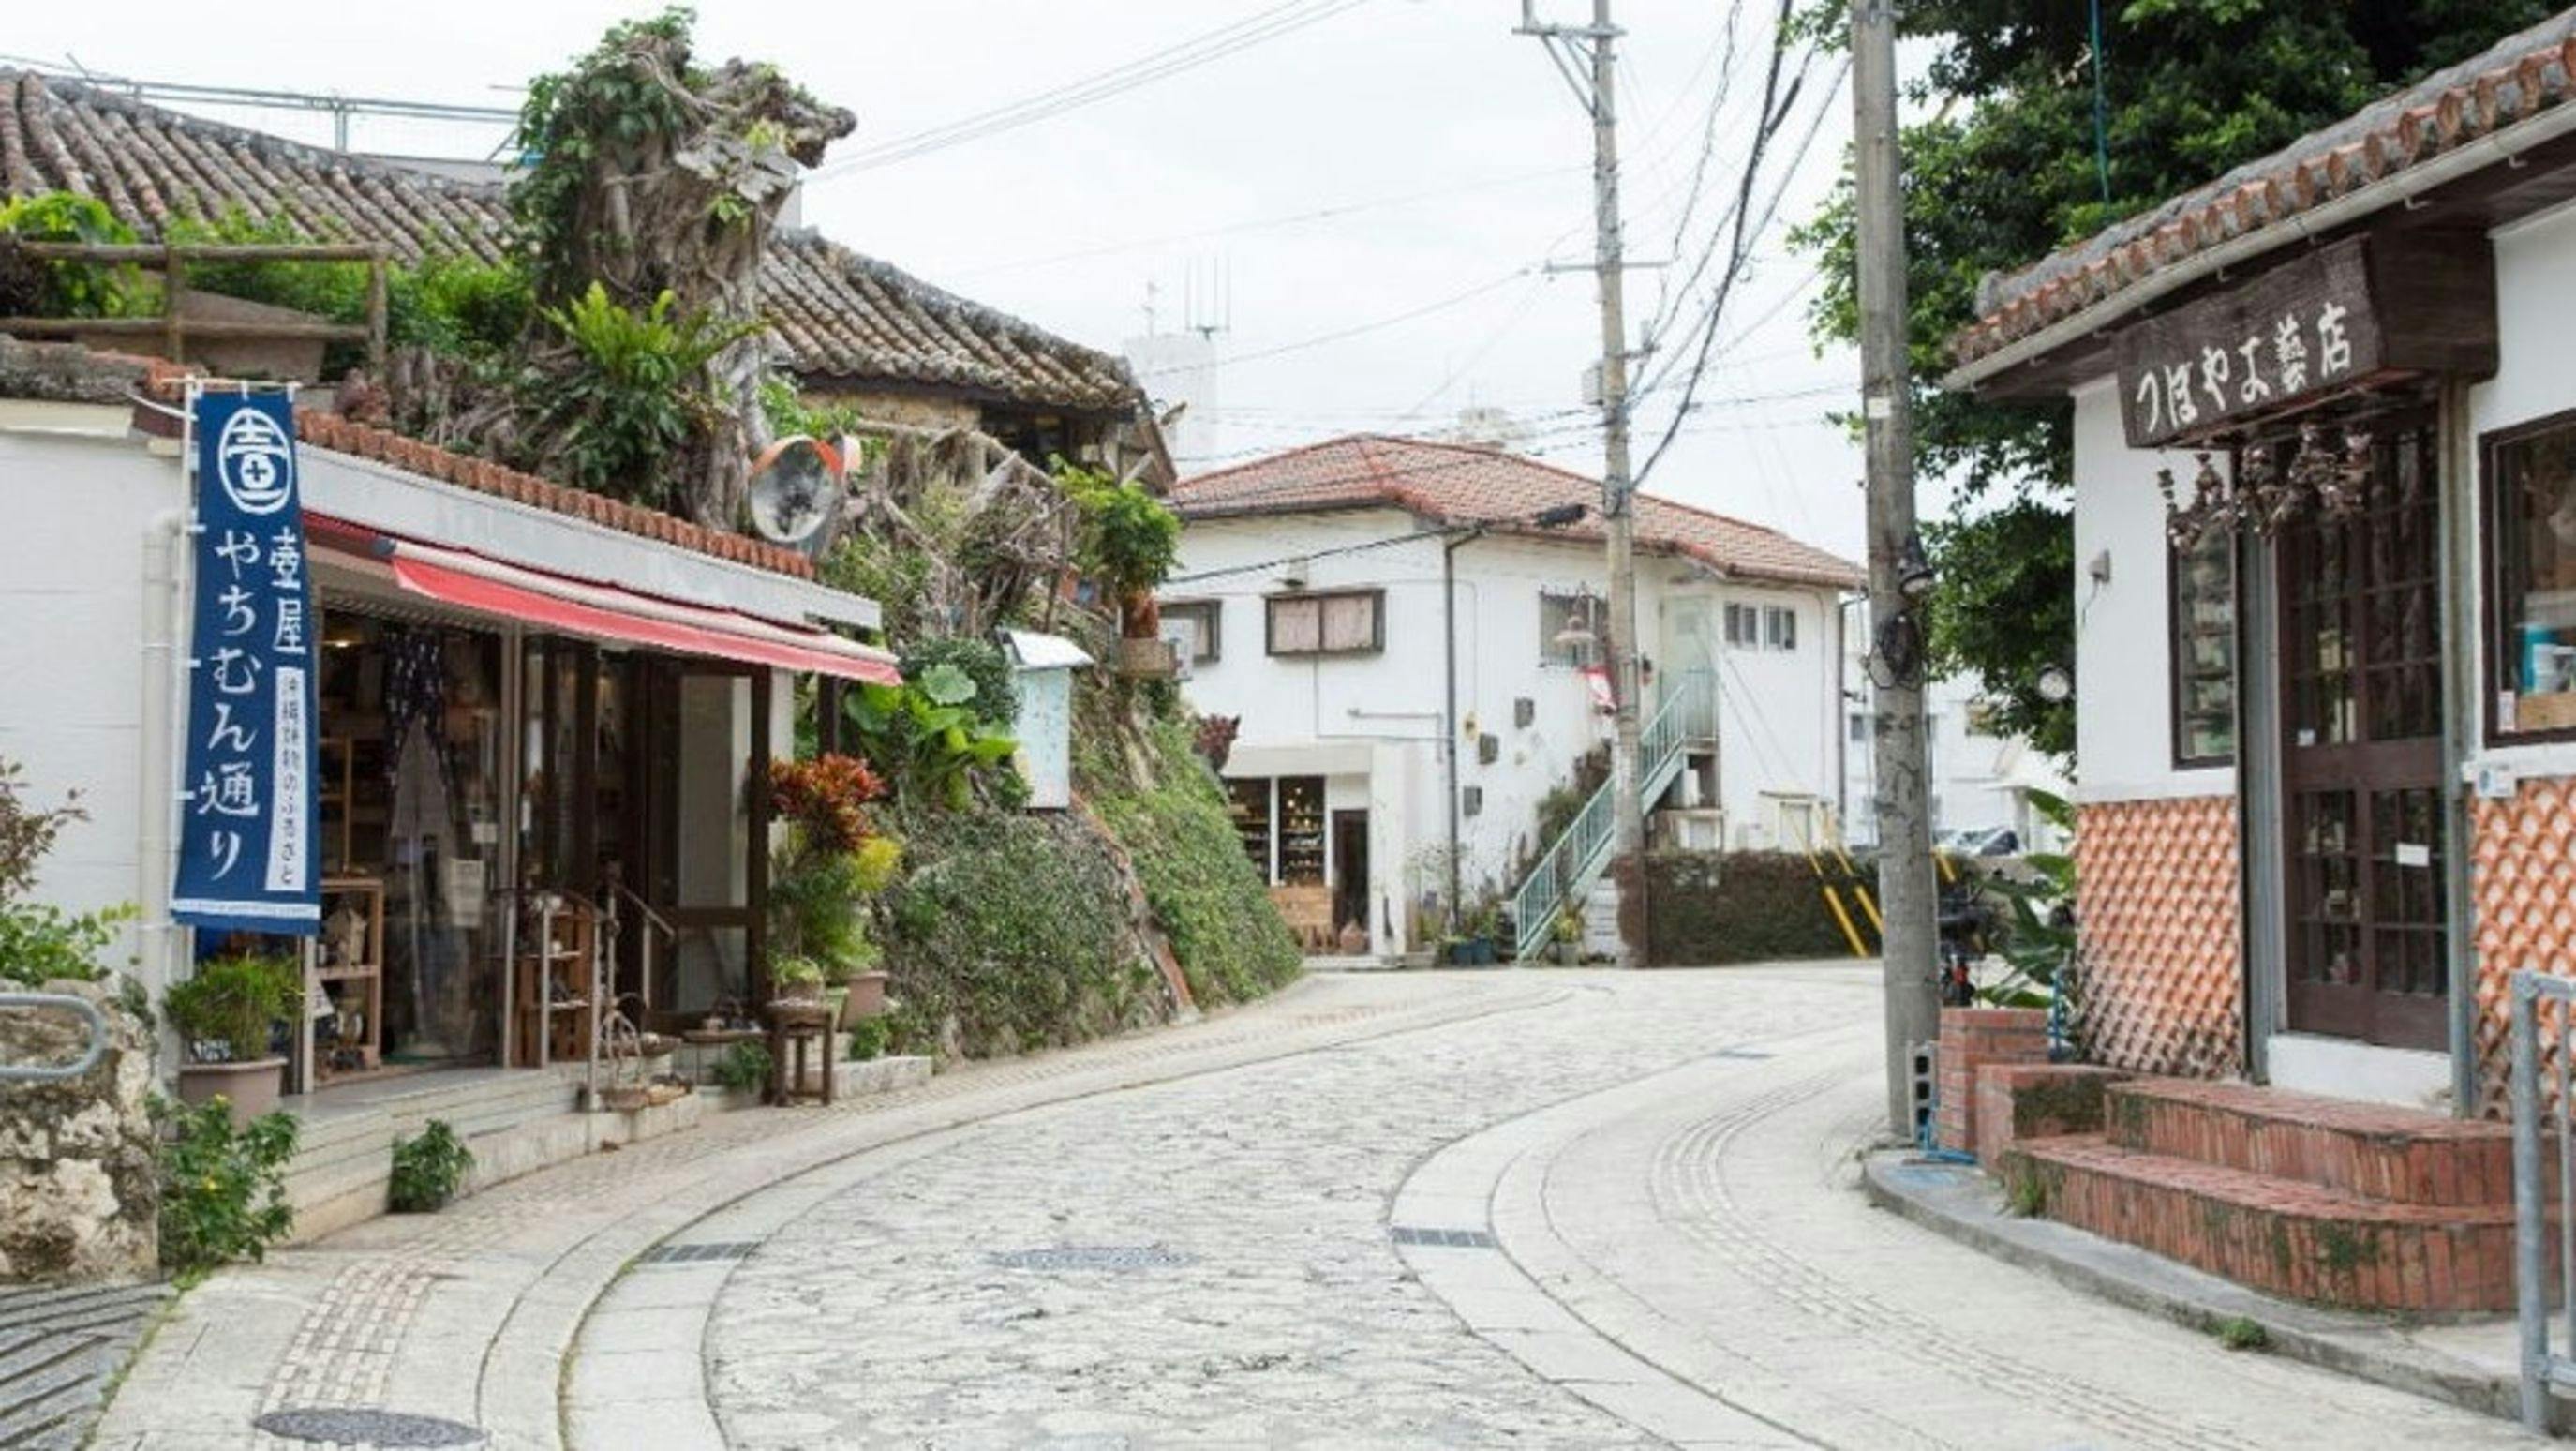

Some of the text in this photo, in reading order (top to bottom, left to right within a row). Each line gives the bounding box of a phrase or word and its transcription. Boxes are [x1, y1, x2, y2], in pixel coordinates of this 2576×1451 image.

[196, 530, 262, 883] やちむん通り
